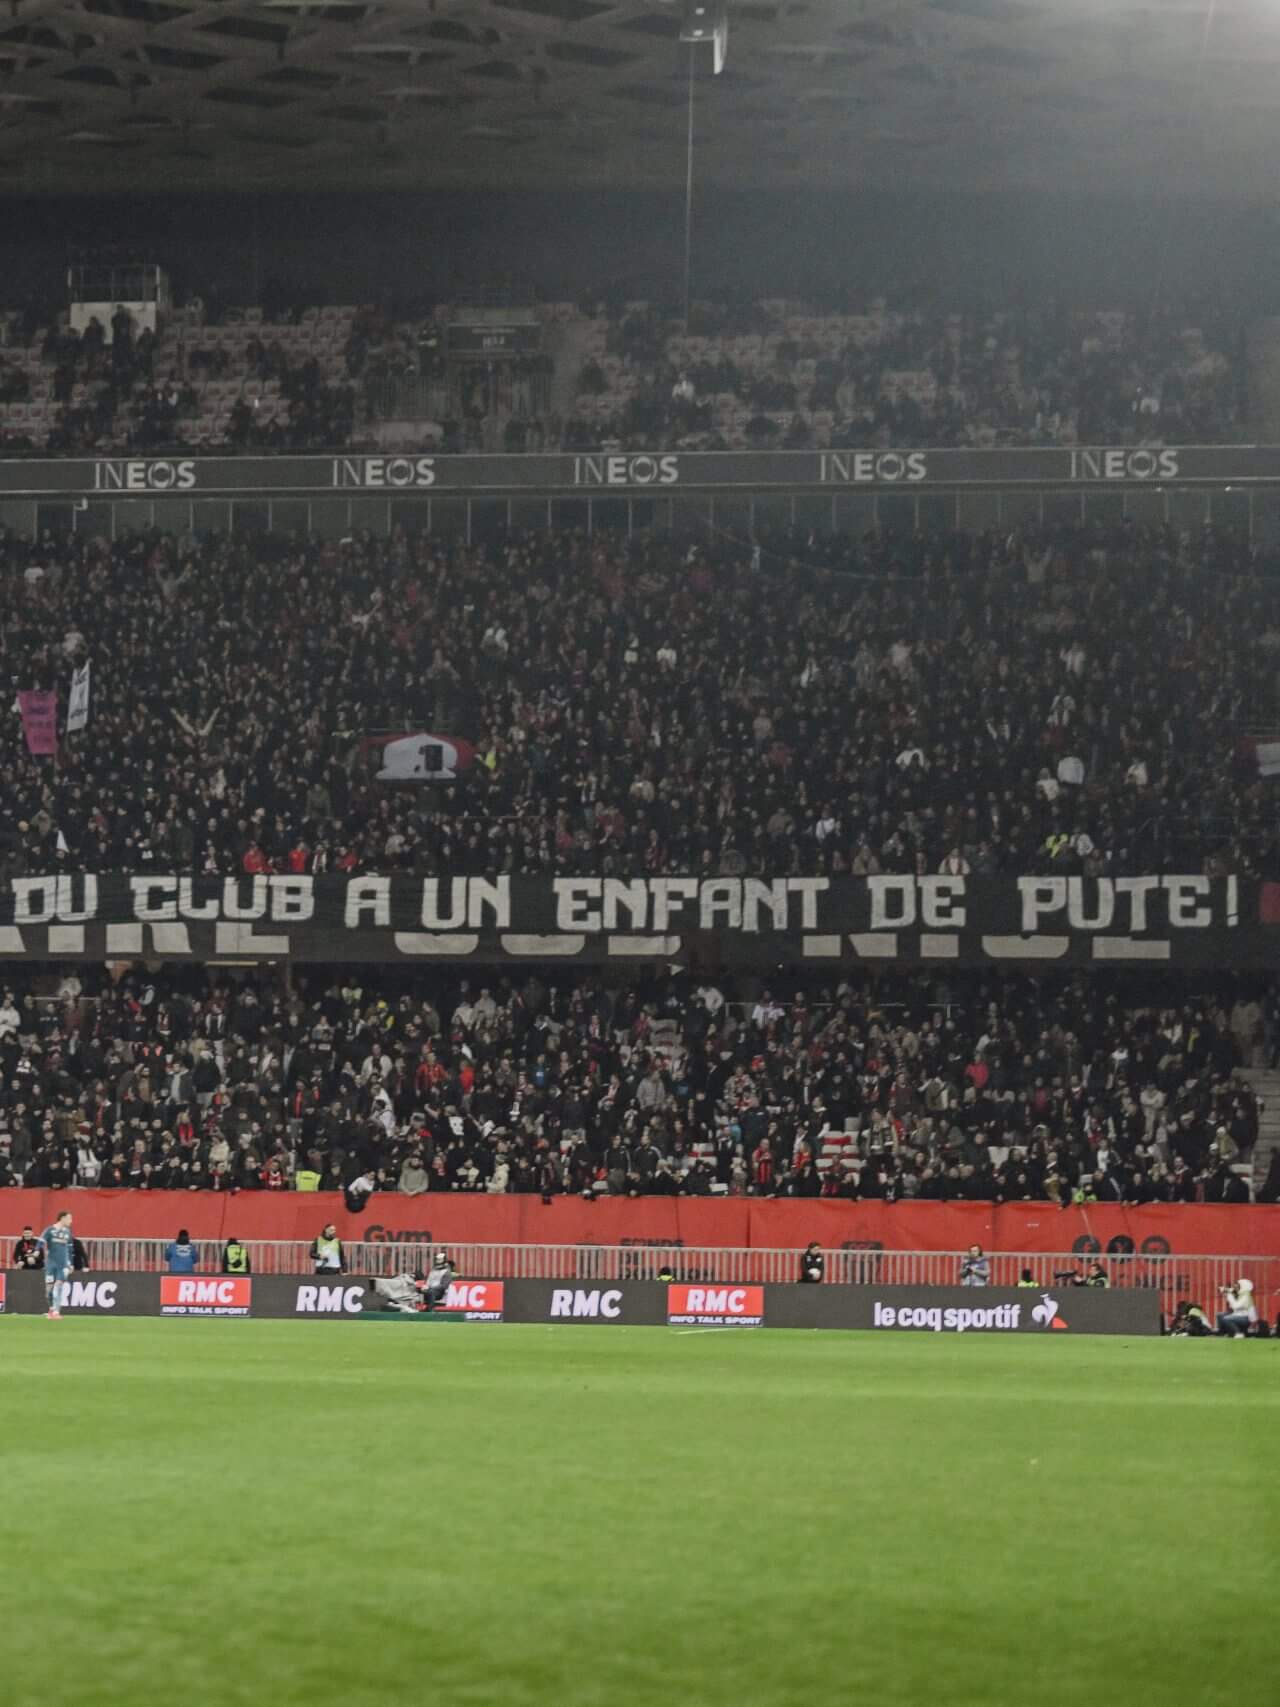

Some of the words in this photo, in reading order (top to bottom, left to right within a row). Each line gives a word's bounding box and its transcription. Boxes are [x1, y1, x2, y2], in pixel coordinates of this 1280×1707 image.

[95, 461, 195, 489] INEOS
[332, 459, 434, 486] INEOS
[574, 456, 678, 483] INEOS
[821, 453, 926, 481] INEOS
[1070, 450, 1178, 478] INEOS
[12, 874, 98, 924] DU
[128, 875, 315, 924] CLUB
[422, 875, 511, 929] UN
[553, 877, 830, 932] ENFANT
[866, 874, 966, 928] DE
[178, 1280, 235, 1303] RMC
[295, 1285, 365, 1313] RMC
[442, 1284, 487, 1308] MC
[550, 1289, 623, 1318] RMC
[686, 1289, 747, 1312] RMC
[188, 1306, 213, 1314] TALK
[465, 1312, 502, 1321] SPORT
[670, 1315, 696, 1323] INFO
[725, 1316, 762, 1324] SPORT
[874, 1302, 896, 1326] le
[897, 1307, 942, 1332] coq
[943, 1303, 1021, 1332] sportif
